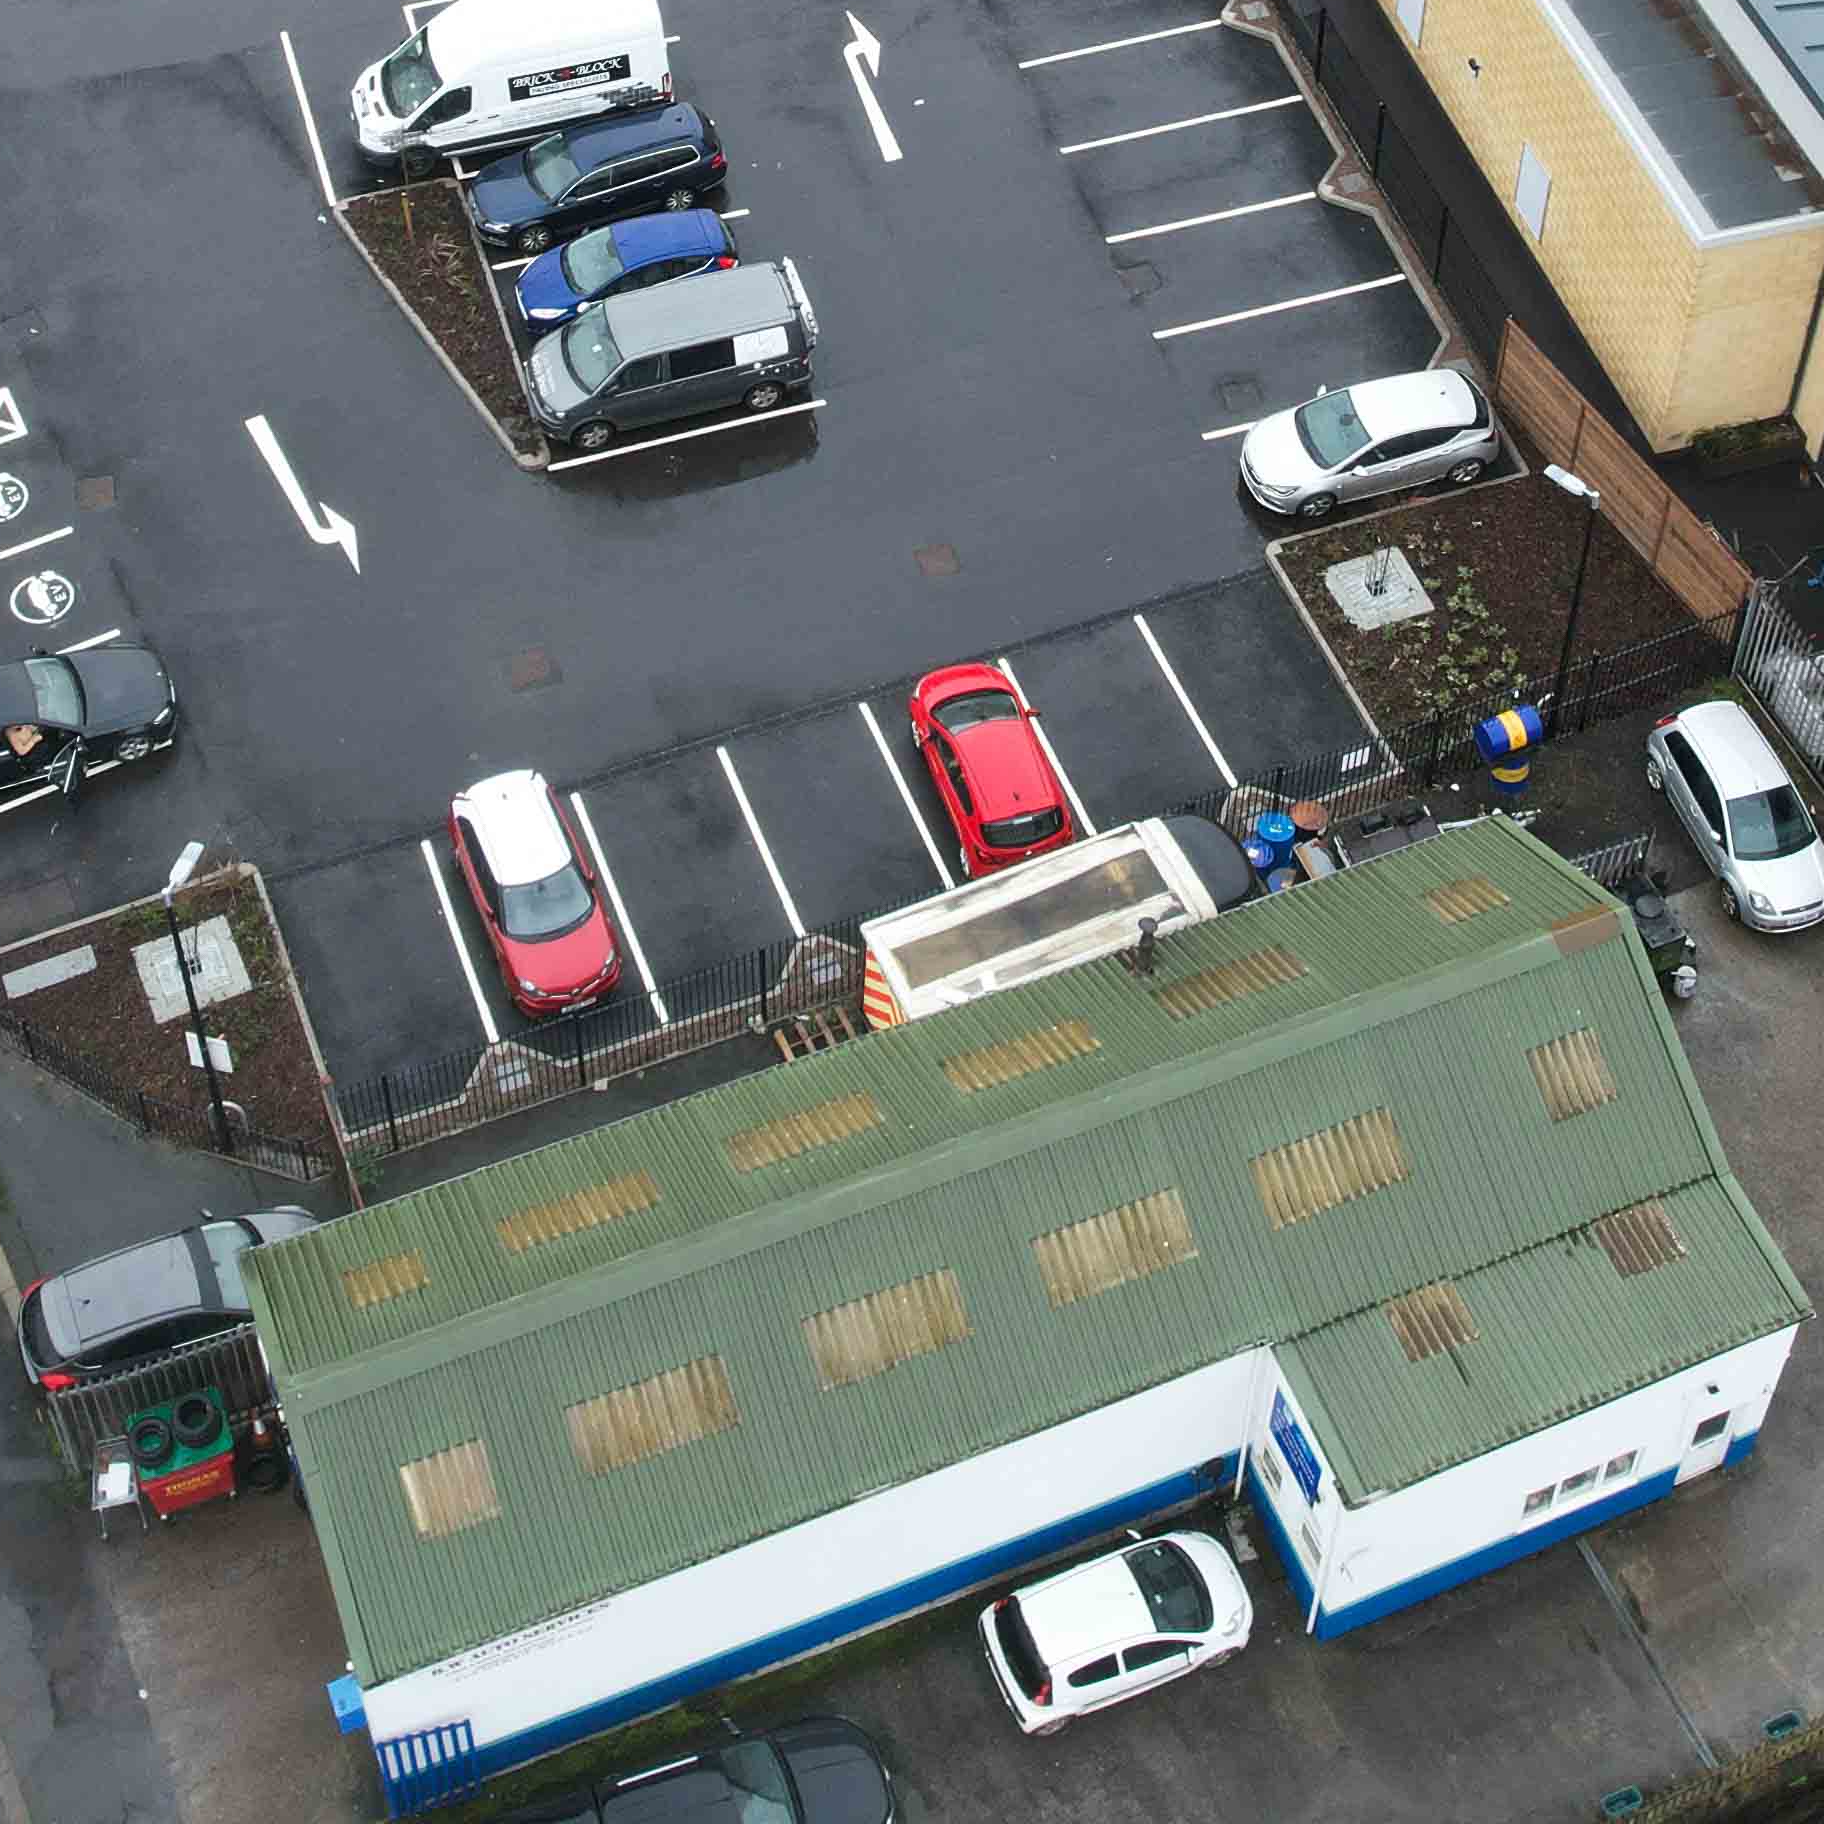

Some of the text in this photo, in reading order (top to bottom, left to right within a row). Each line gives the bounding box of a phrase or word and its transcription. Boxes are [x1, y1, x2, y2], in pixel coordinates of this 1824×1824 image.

[511, 71, 558, 89] BRICK
[574, 57, 624, 76] BLOCK
[4, 485, 23, 503] EV
[49, 584, 68, 603] EV
